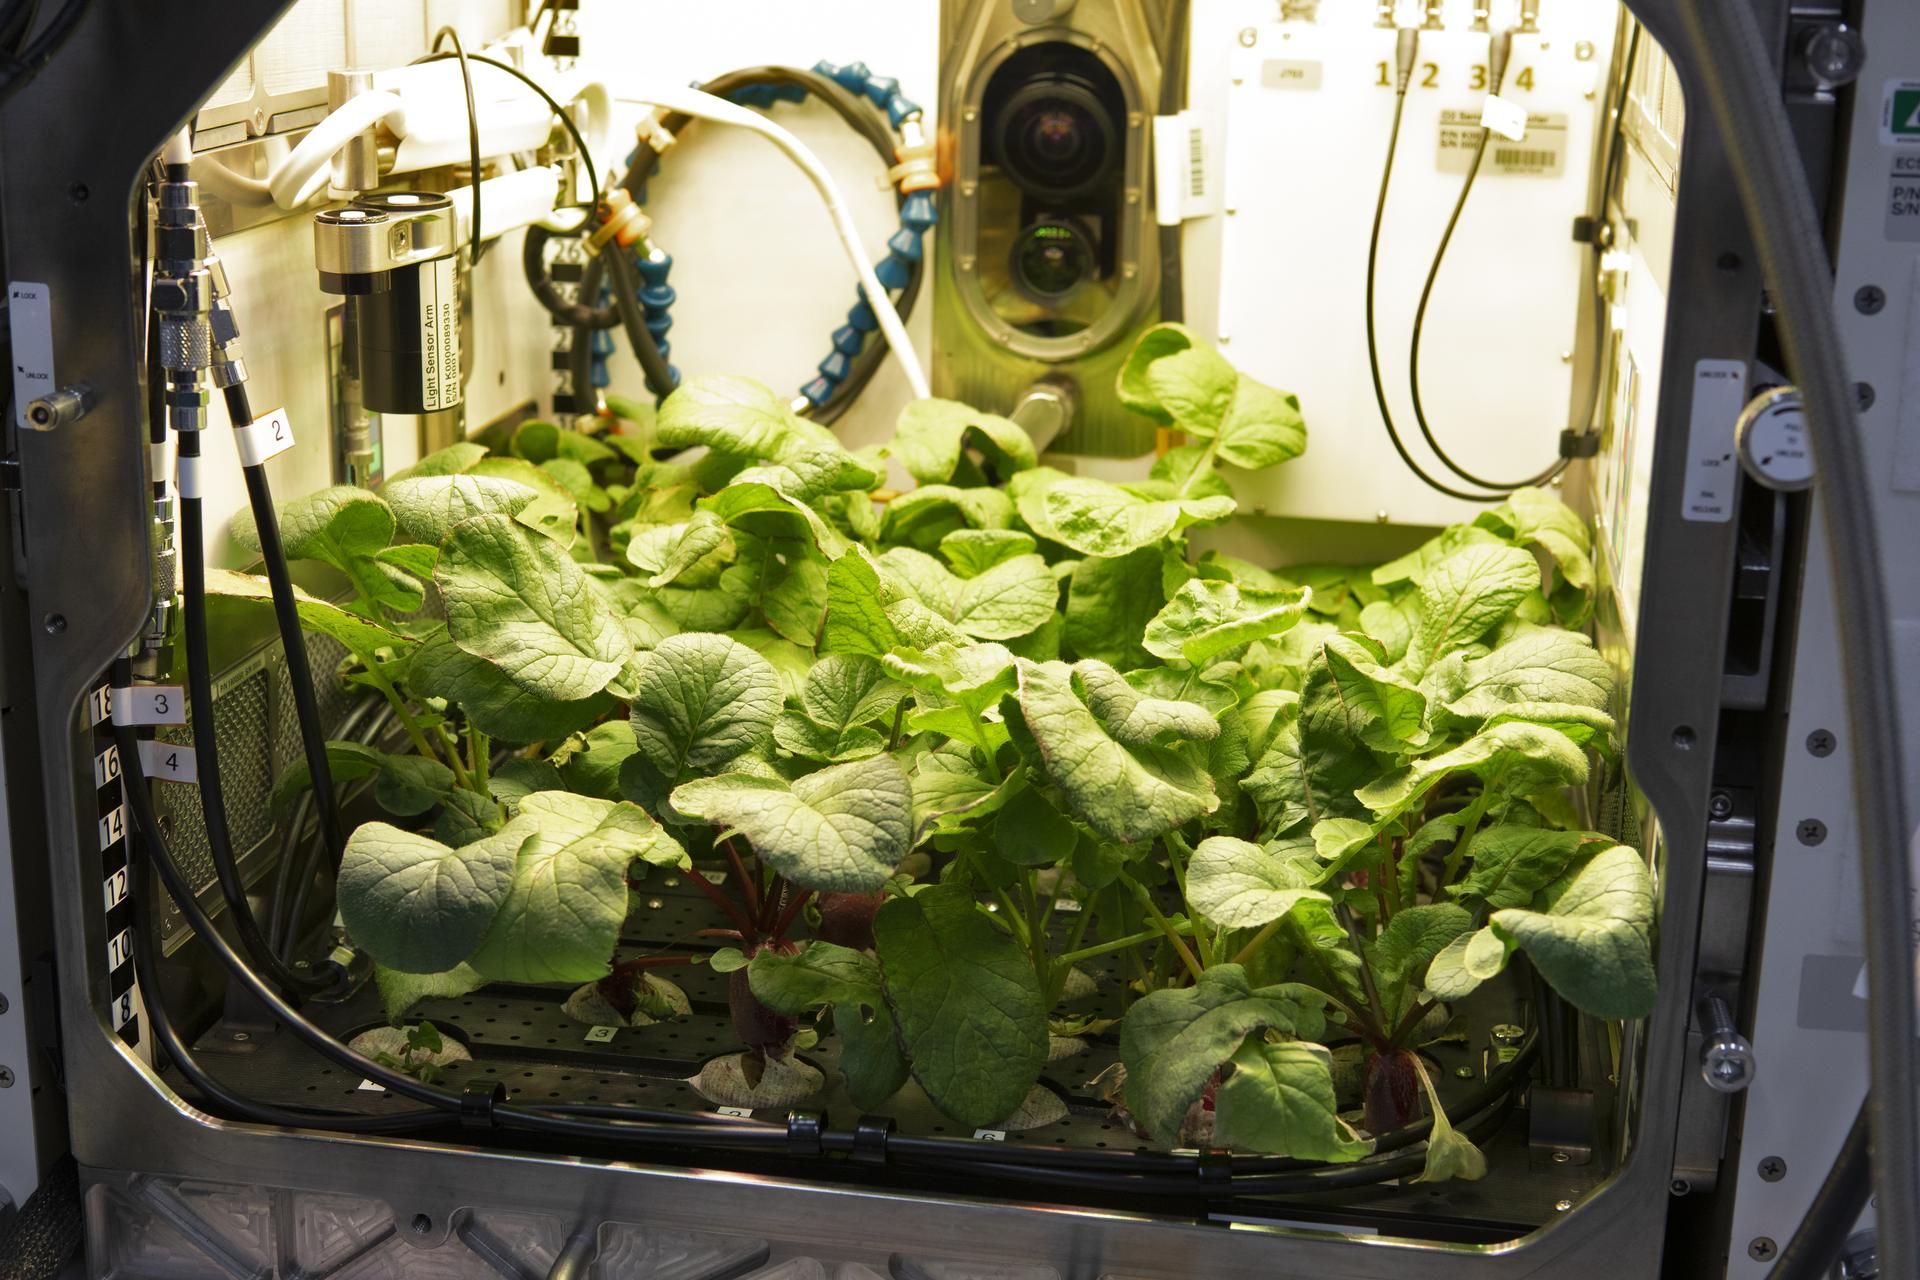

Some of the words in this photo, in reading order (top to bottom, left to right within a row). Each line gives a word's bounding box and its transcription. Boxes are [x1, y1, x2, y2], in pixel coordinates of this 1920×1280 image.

[1376, 61, 1392, 87] 1
[1421, 62, 1439, 88] 2
[1469, 64, 1487, 90] 3
[1515, 66, 1534, 91] 4
[1891, 202, 1920, 216] S/N
[555, 240, 580, 264] 26
[21, 292, 37, 300] LOCK
[425, 304, 434, 329] Arm
[425, 333, 436, 375] Sensor
[26, 372, 48, 380] UNLOCK
[427, 377, 438, 407] Light
[445, 383, 453, 404] P/N
[272, 420, 284, 441] 2
[95, 686, 112, 721] 18
[155, 694, 169, 714] 3
[99, 746, 118, 783] 16
[165, 752, 179, 772] 4
[103, 808, 123, 845] 14
[108, 870, 127, 906] 12
[112, 929, 131, 967] 10
[121, 993, 130, 1023] 8
[595, 1029, 608, 1038] 3
